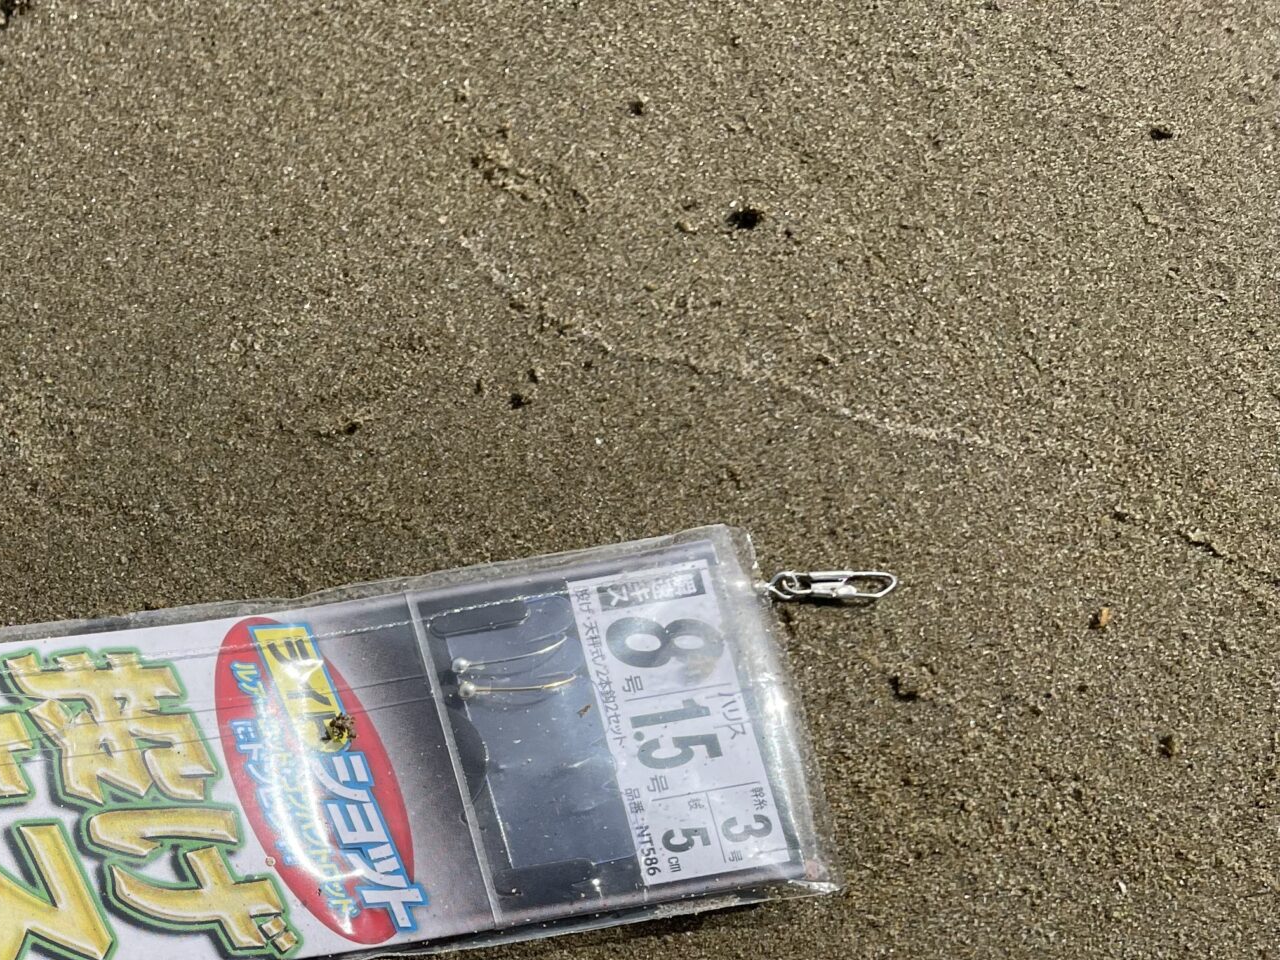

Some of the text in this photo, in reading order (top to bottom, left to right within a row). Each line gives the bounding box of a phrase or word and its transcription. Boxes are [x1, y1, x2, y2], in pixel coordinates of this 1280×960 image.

[717, 692, 747, 740] ハリス
[4, 651, 300, 954] 投げ
[750, 786, 766, 811] 幹糸
